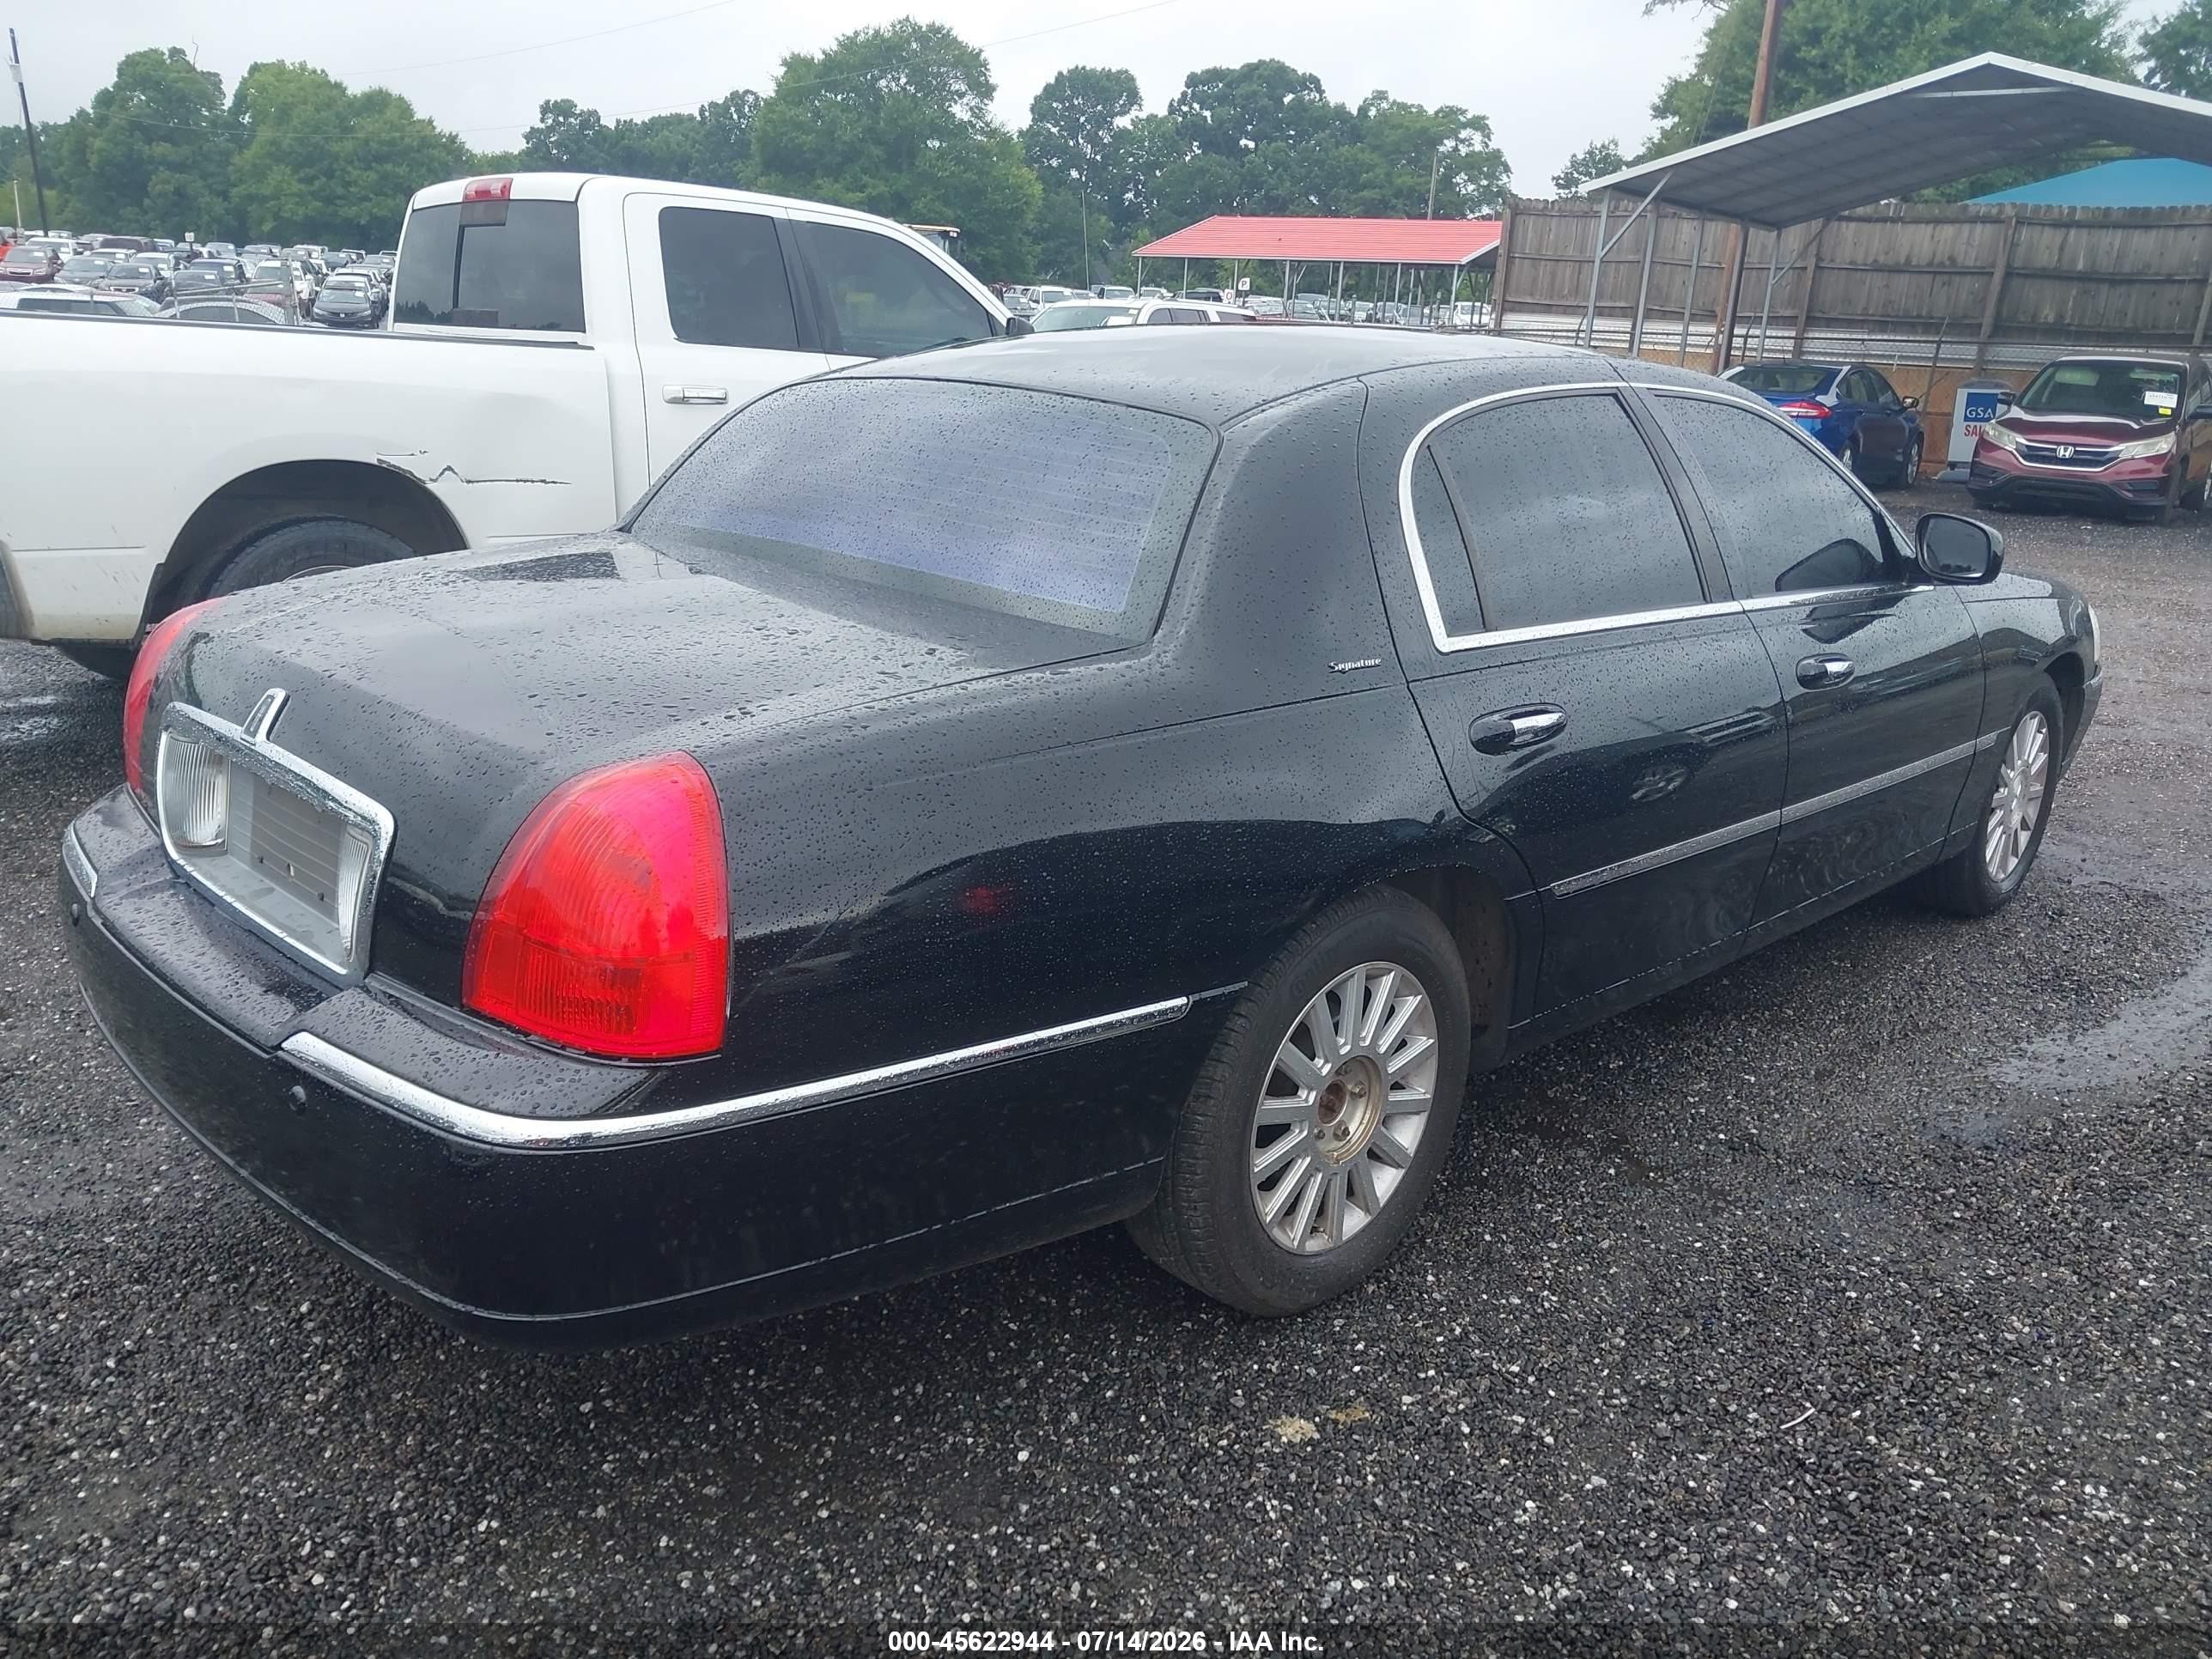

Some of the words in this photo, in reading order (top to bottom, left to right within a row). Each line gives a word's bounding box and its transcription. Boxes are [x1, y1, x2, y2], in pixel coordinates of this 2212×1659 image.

[1241, 280, 1248, 289] P
[1966, 406, 1994, 419] GSA
[1329, 658, 1382, 672] Signature
